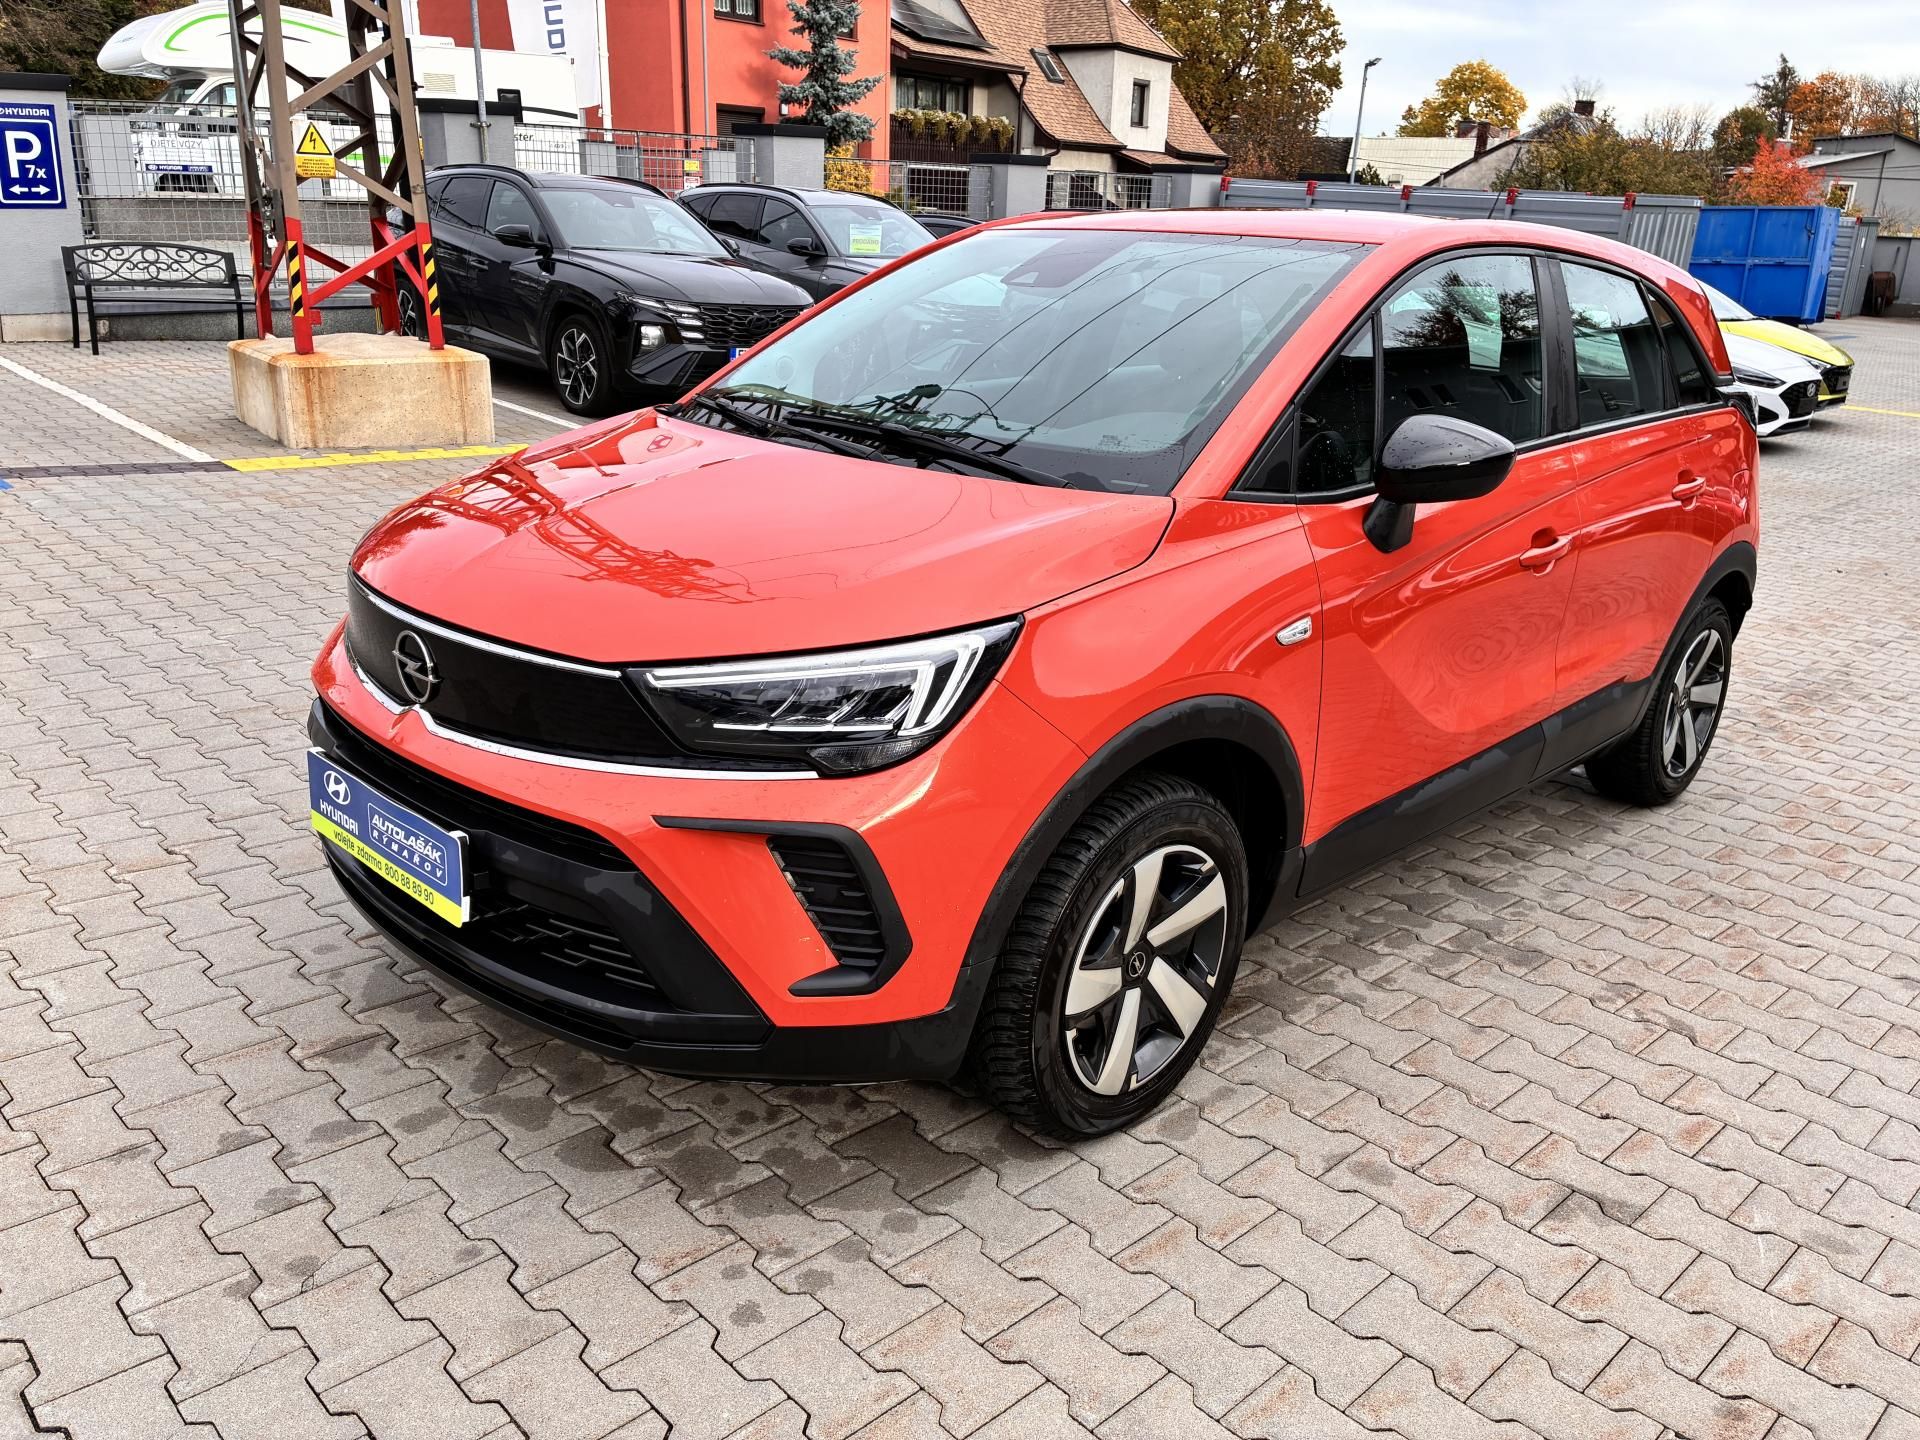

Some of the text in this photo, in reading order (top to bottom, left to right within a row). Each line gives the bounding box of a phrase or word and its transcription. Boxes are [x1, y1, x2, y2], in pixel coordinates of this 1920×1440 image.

[5, 107, 50, 117] HYUNDAI
[4, 130, 42, 179] P
[25, 164, 47, 179] 7x
[320, 798, 359, 836] HYUNDAI
[371, 814, 442, 864] AUTOLAŠÁK
[333, 829, 434, 905] volejte zdarma 800 88 89 90
